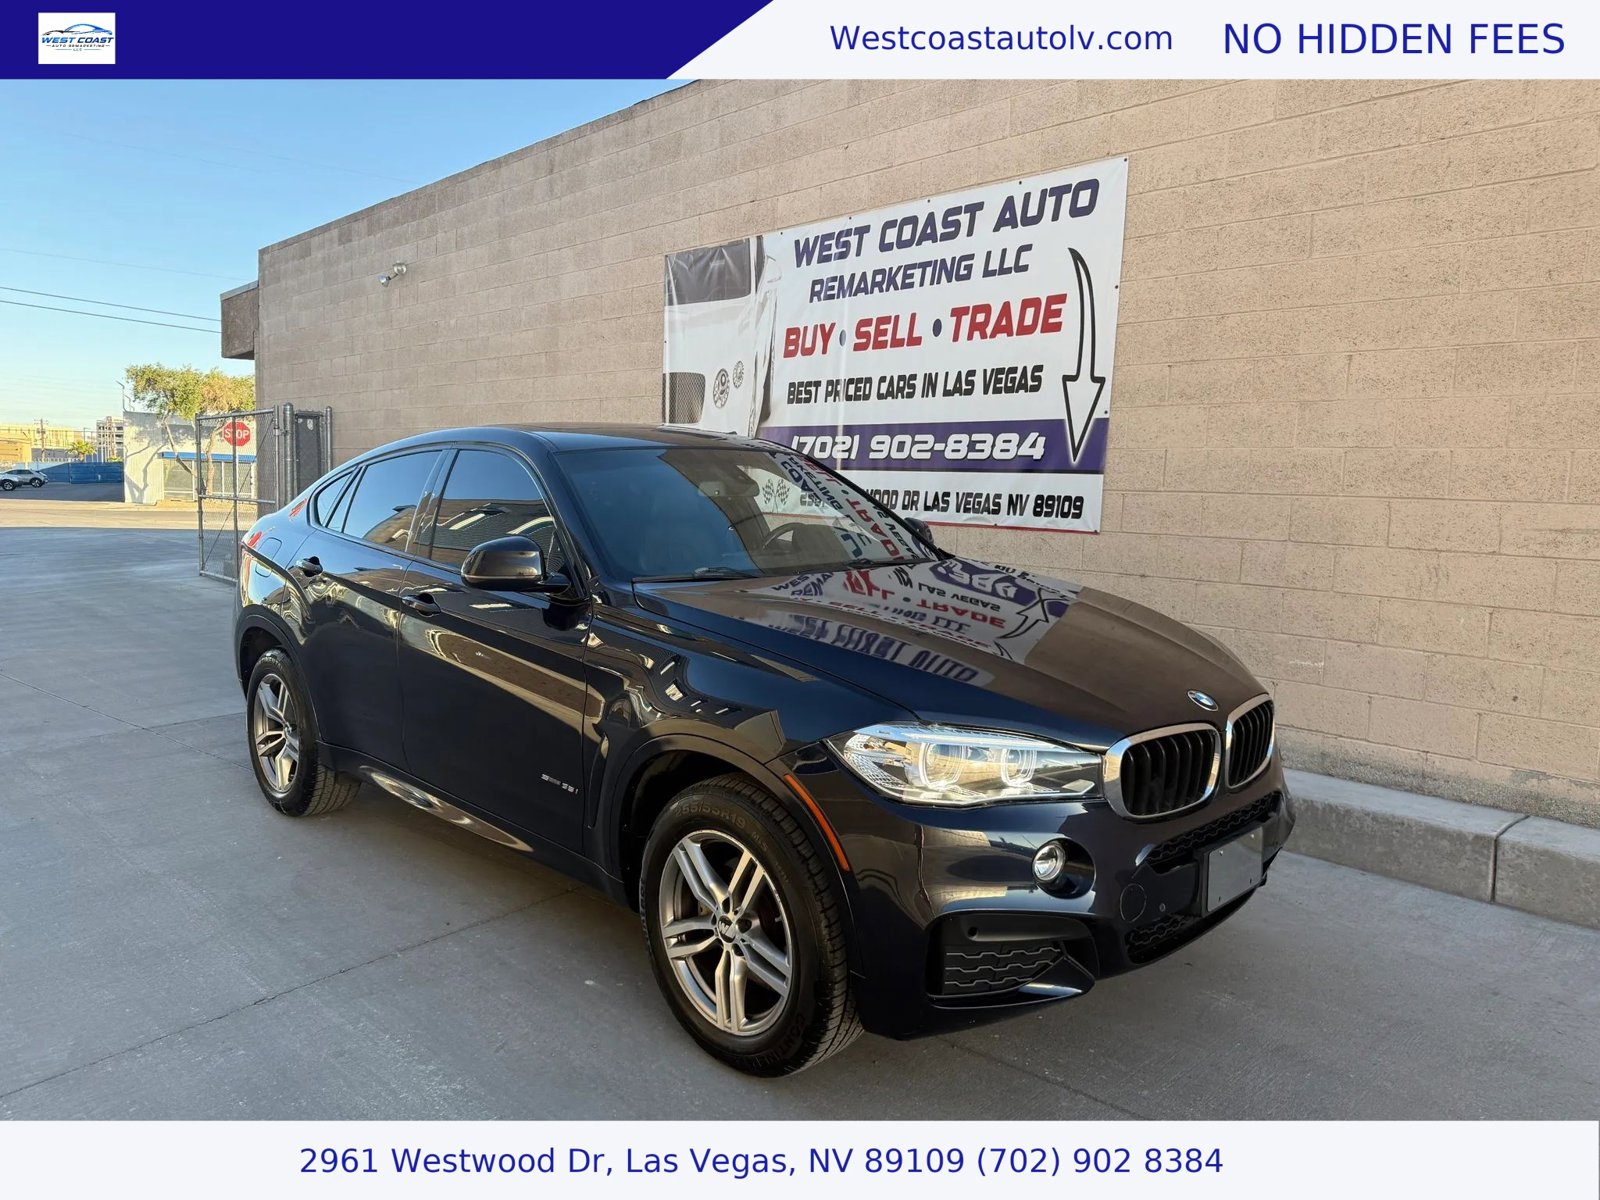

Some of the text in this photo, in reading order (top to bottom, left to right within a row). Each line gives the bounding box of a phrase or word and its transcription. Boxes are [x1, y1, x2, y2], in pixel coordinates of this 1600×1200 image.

[794, 178, 1100, 268] WEST COAST AUTO
[809, 244, 1034, 304] REMARKETING LLC
[783, 293, 1068, 359] BUY SELL TRADE
[786, 364, 1045, 405] BEST PRICED CARS IN LAS VEGAS
[868, 431, 1047, 461] 902-8384
[901, 490, 920, 511] DR
[923, 490, 951, 512] LAS
[955, 491, 1002, 514] VEGAS
[1006, 493, 1030, 517] NV
[1032, 494, 1085, 519] 89109
